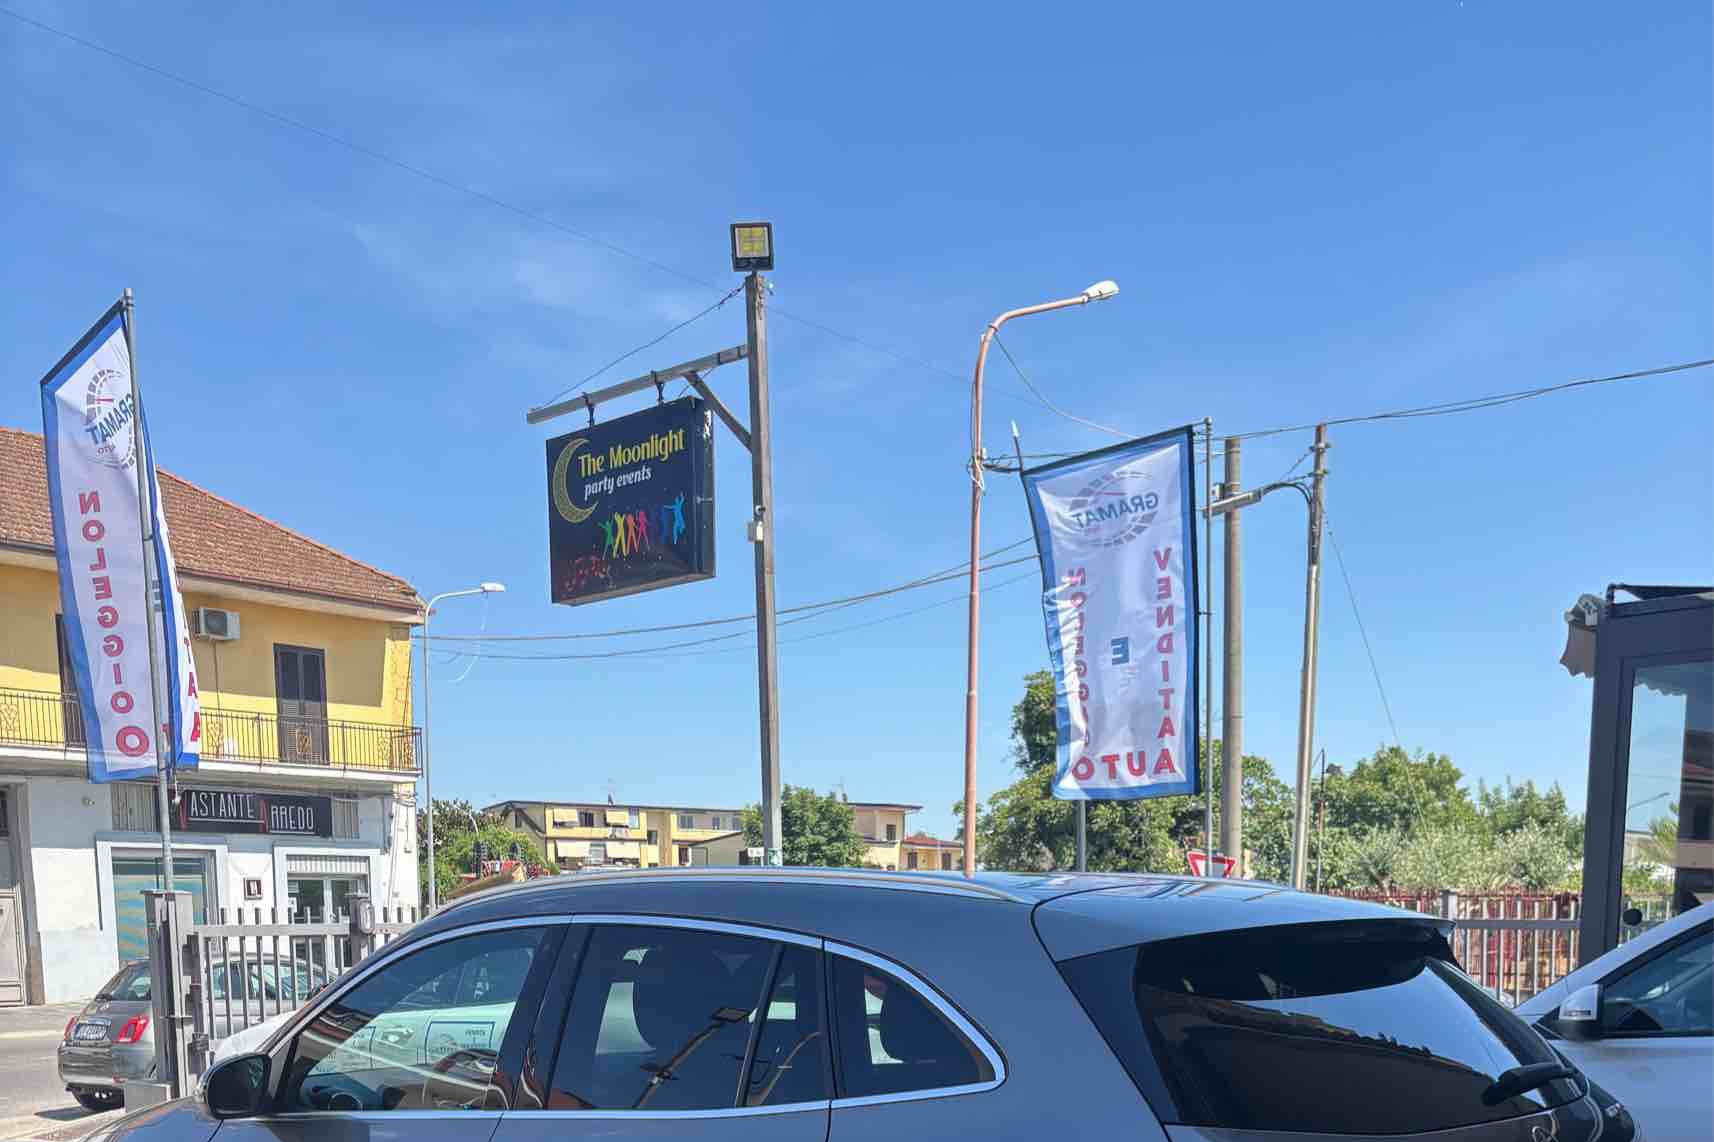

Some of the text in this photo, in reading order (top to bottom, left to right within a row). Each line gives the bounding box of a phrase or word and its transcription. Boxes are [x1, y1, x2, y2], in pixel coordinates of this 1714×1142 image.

[578, 428, 684, 478] The Moonlight
[584, 465, 653, 502] party events
